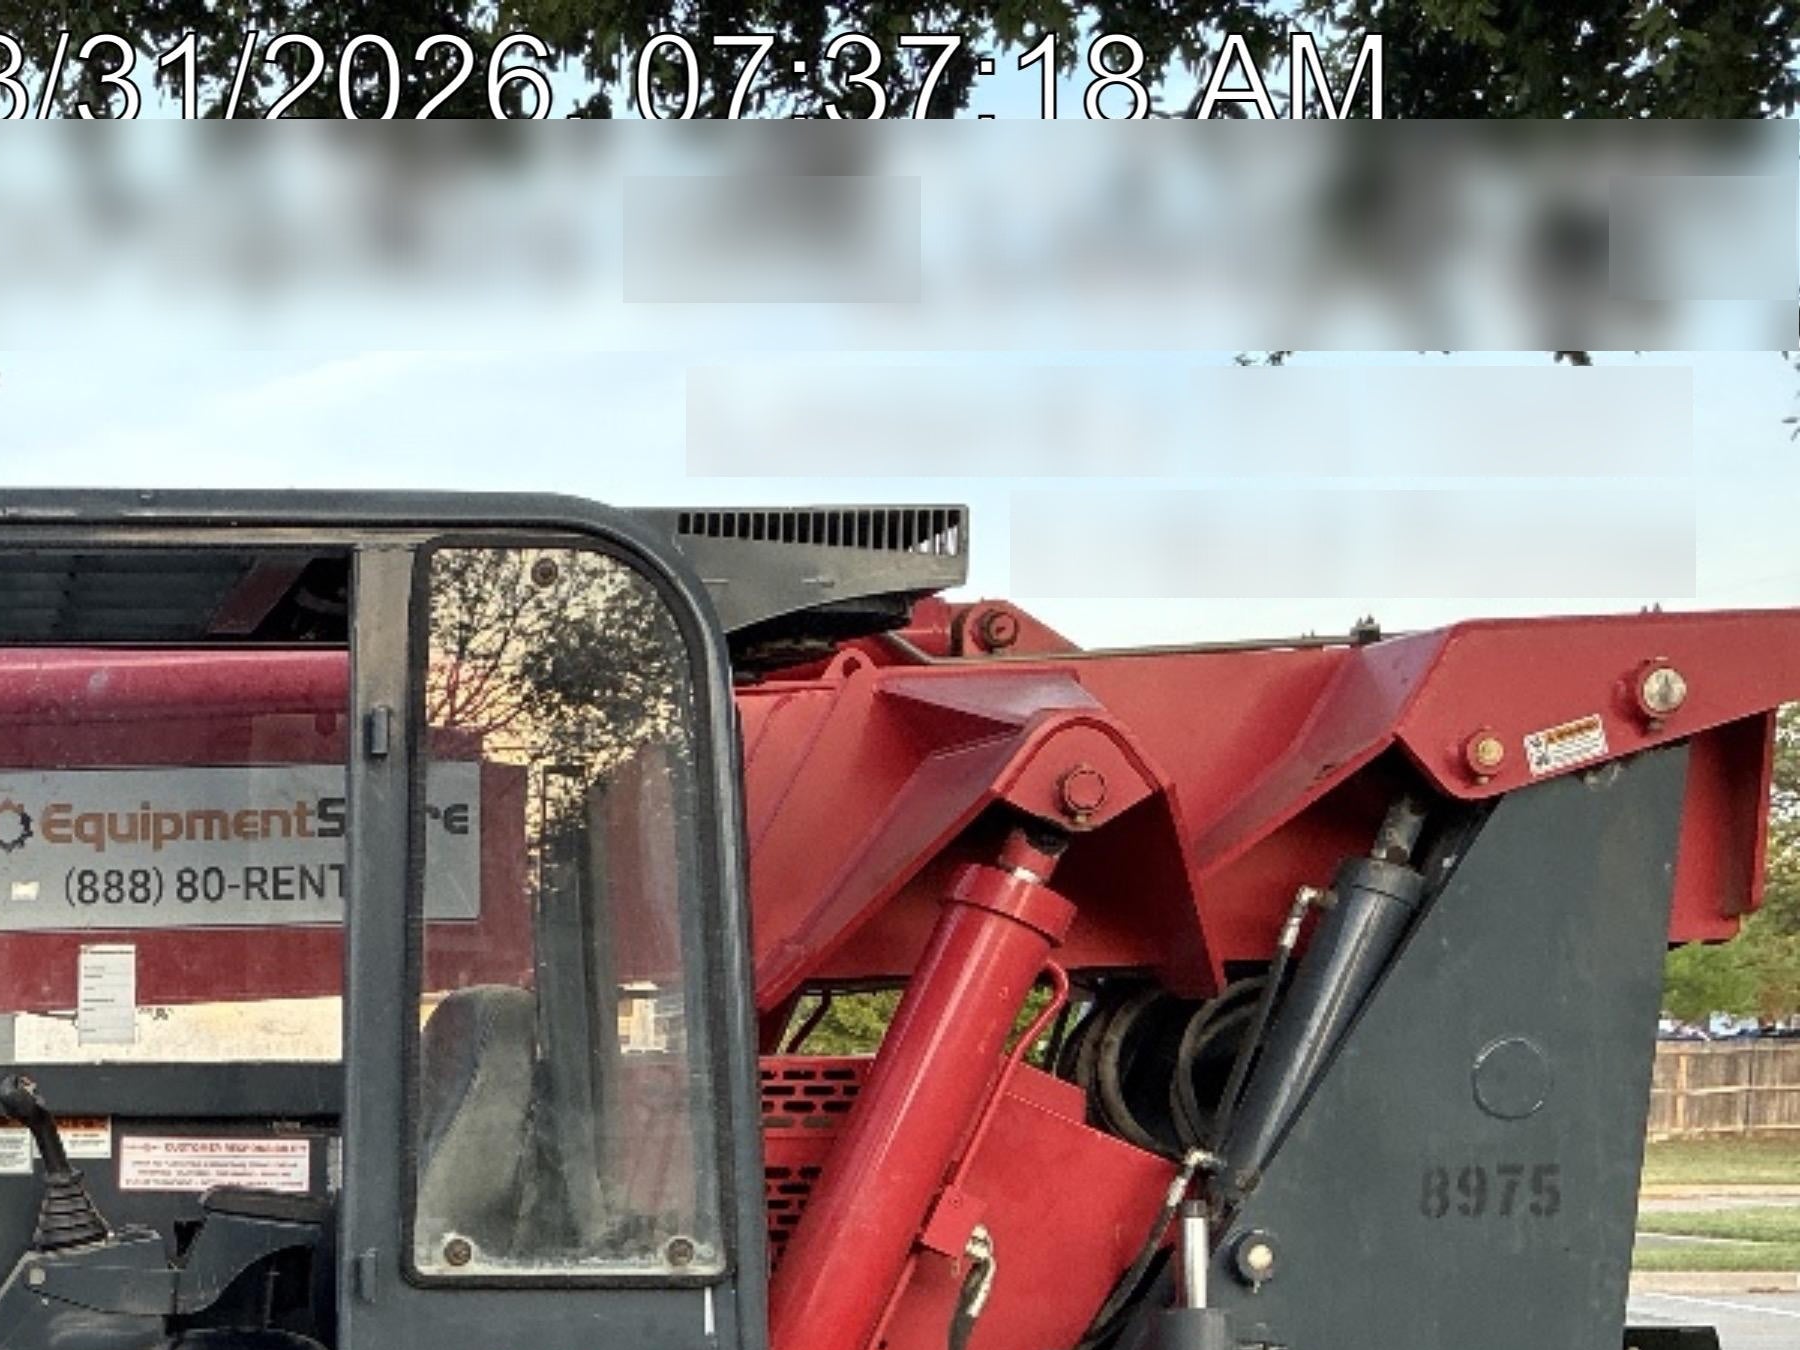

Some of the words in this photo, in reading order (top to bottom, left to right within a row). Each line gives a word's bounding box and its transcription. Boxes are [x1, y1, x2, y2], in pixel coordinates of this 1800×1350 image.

[41, 797, 469, 852] EquipmentSe
[65, 866, 163, 907] (888)
[1420, 1164, 1561, 1218] 8975
